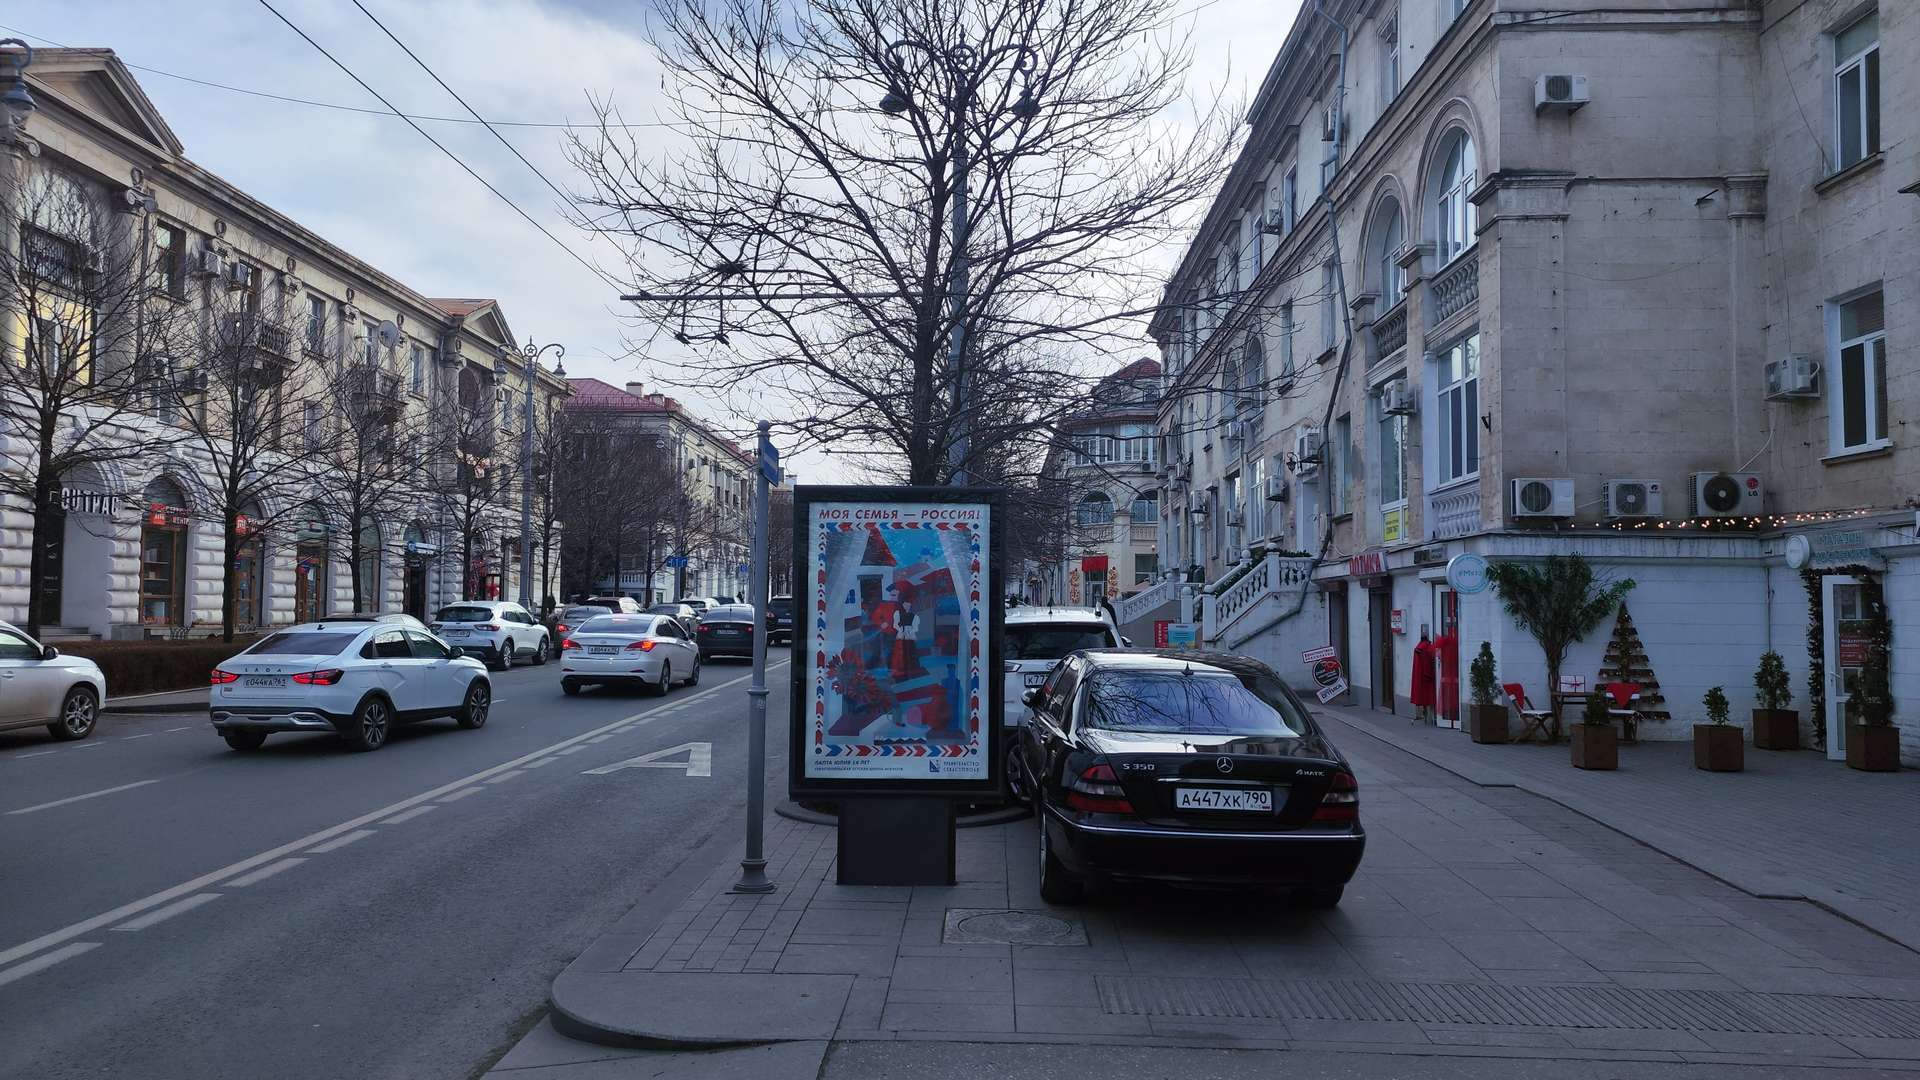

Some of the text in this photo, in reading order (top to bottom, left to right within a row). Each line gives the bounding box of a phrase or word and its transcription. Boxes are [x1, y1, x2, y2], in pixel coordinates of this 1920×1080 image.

[819, 509, 850, 520] МОЯ
[855, 509, 899, 520] СЕМЬЯ
[921, 509, 981, 520] РОССИЯ!
[1132, 763, 1155, 771] 350
